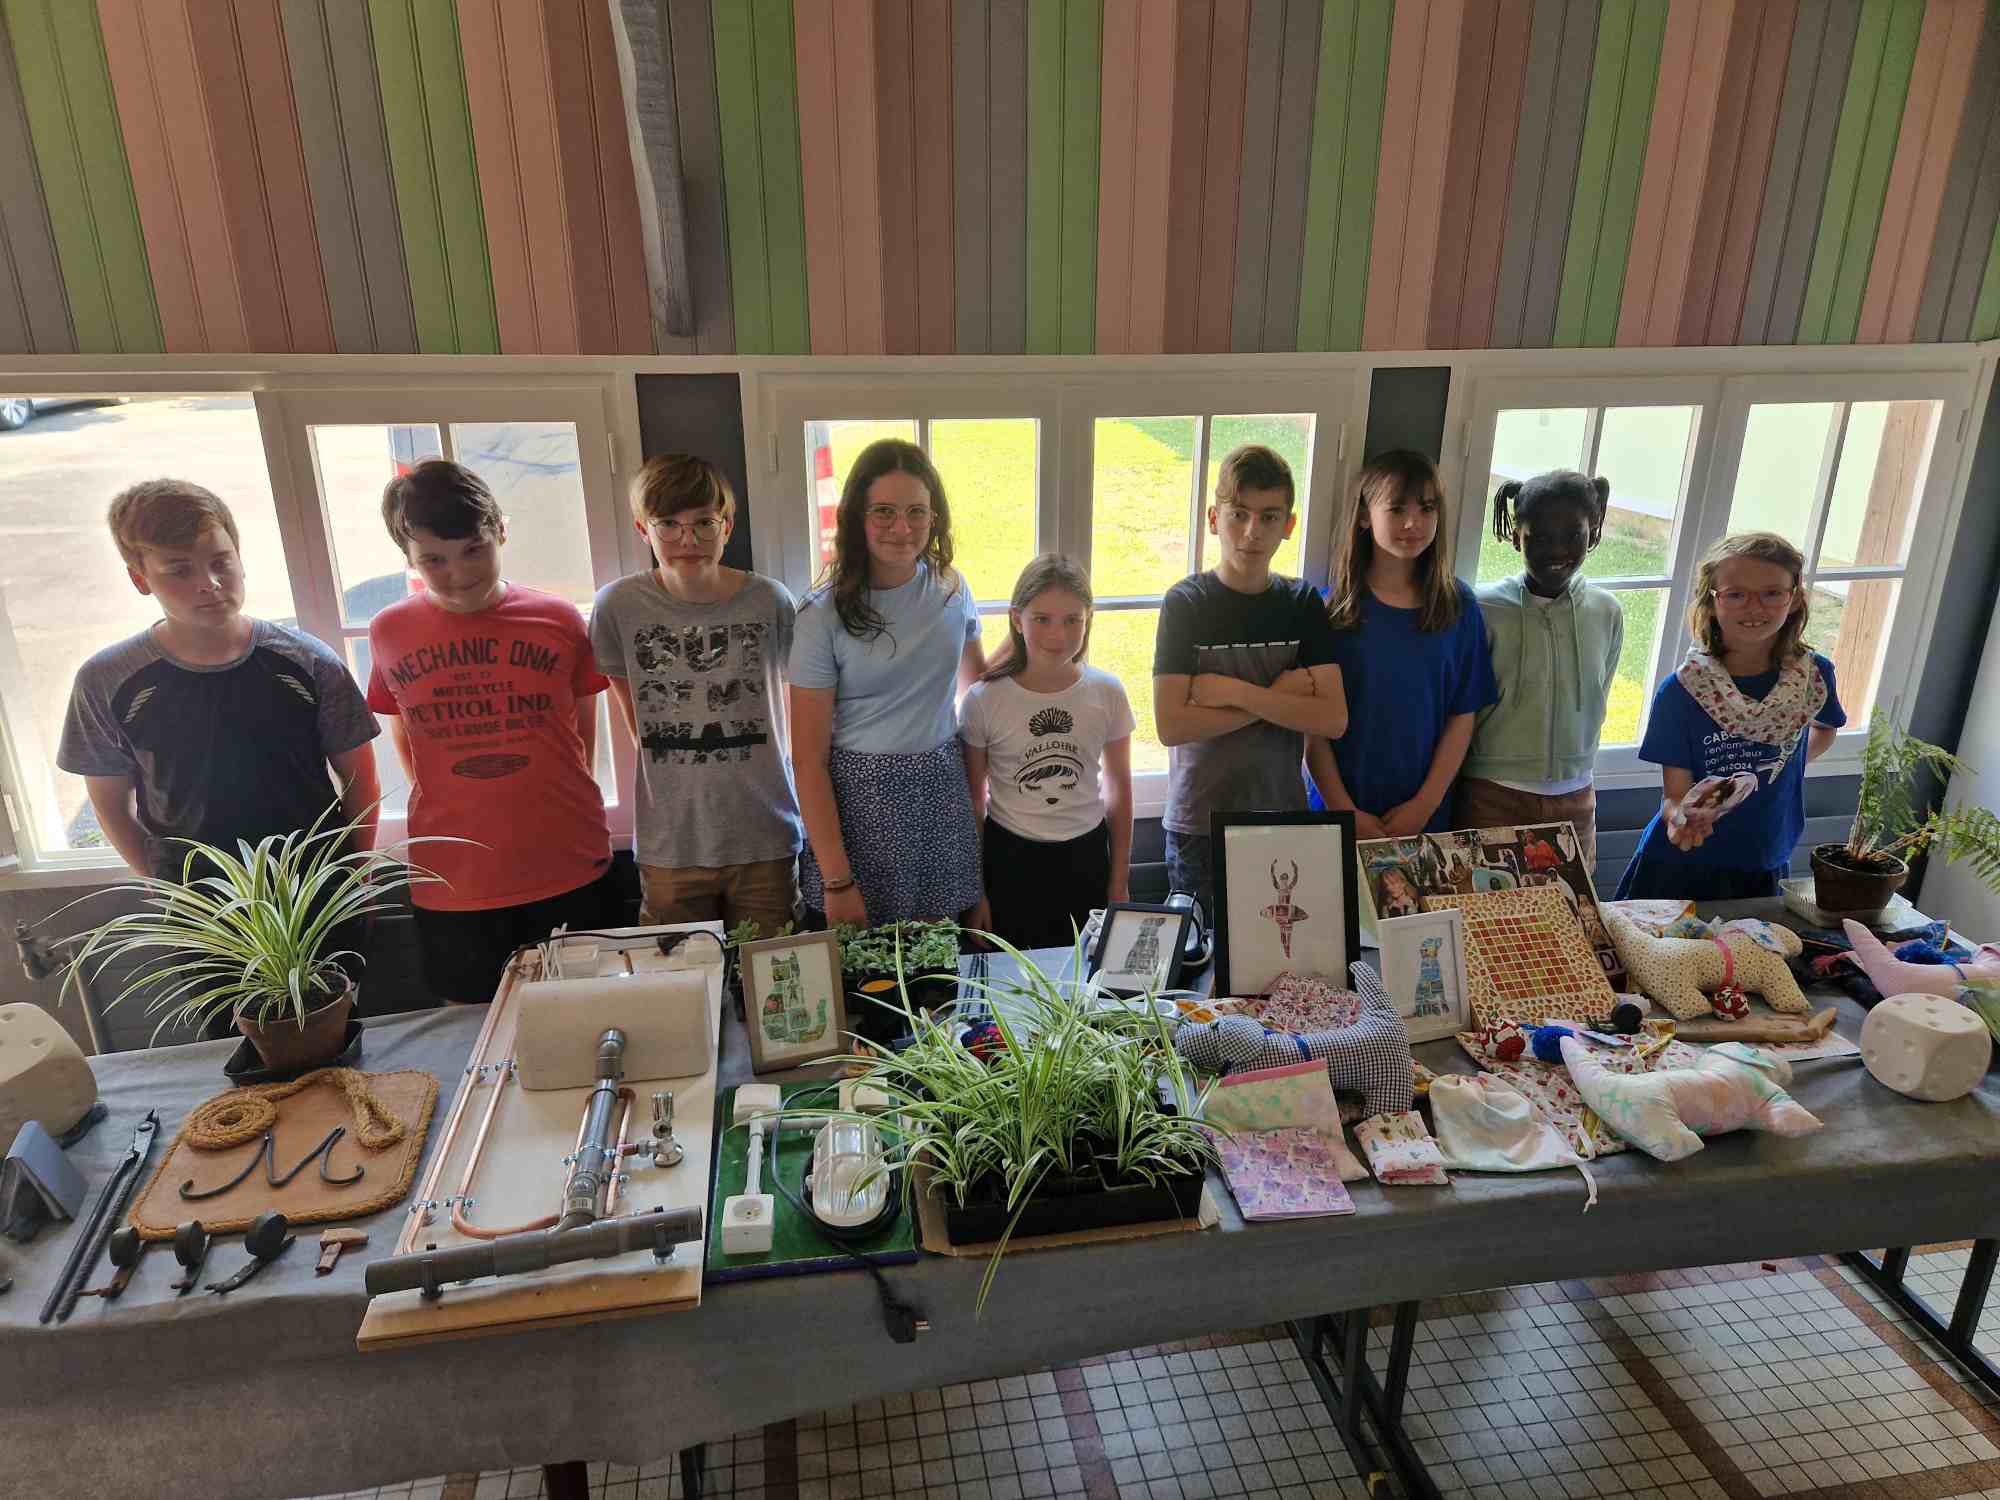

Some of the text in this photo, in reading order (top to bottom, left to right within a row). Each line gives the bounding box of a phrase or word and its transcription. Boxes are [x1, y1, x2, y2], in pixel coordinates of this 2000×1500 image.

[634, 623, 768, 674] OUT
[389, 637, 499, 689] MECHANIC
[406, 698, 502, 724] PETROL
[1025, 740, 1078, 760] VALLOIRE
[1729, 762, 1752, 772] 2024
